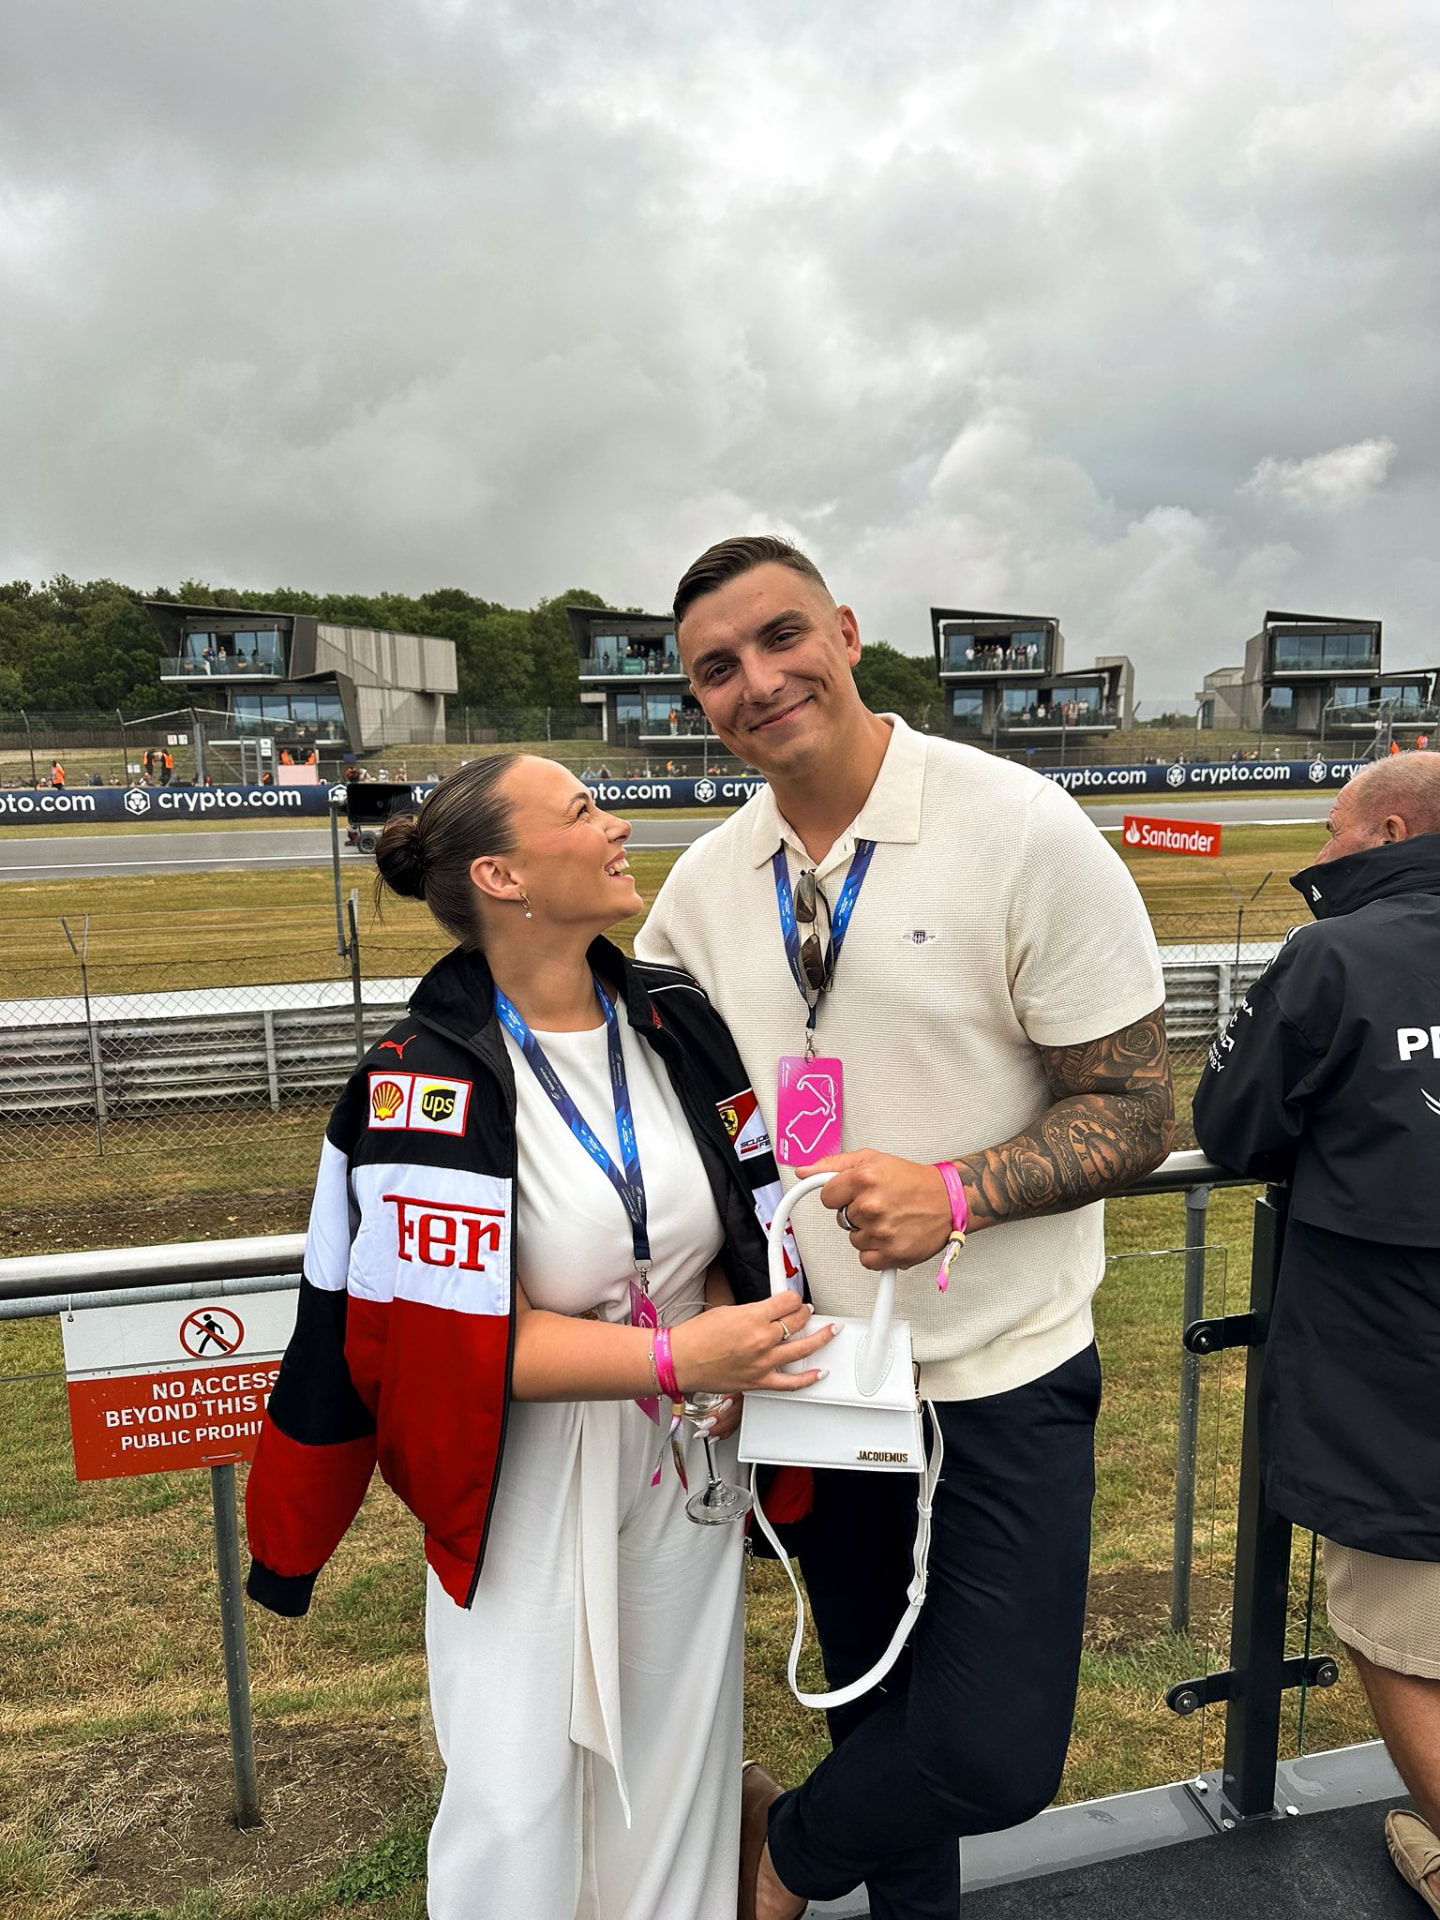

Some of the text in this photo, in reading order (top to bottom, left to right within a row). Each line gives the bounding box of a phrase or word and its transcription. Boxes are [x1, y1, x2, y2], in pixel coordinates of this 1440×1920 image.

[1190, 765, 1291, 784] crypto.com
[158, 788, 302, 812] crypto.com
[1141, 825, 1214, 852] Santander
[423, 1095, 454, 1118] ups
[152, 1370, 280, 1400] NO ACCESS
[105, 1402, 198, 1428] BEYOND
[202, 1395, 258, 1417] THIS
[121, 1429, 191, 1450] PUBLIC
[856, 1450, 908, 1463] JACQUEMUS
